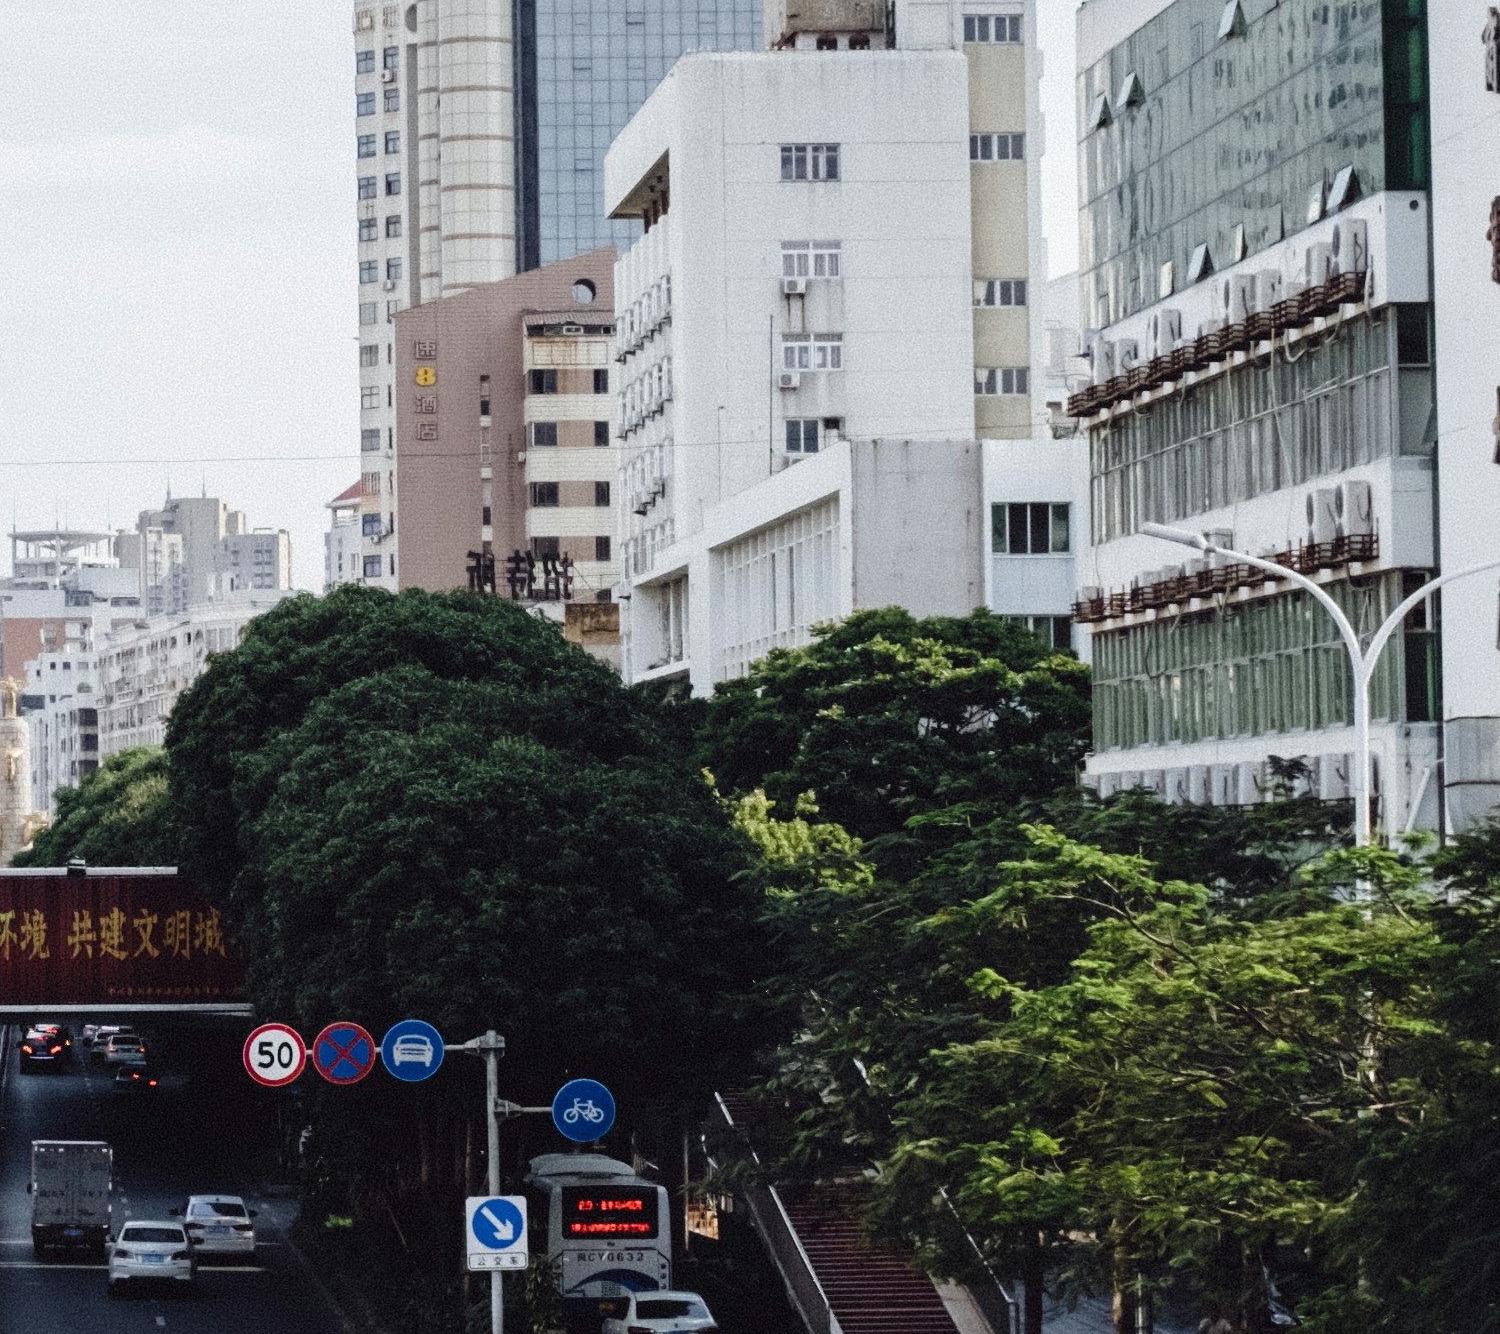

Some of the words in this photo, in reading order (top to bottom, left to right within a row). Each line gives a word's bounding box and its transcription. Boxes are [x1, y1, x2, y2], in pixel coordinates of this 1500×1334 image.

[414, 339, 438, 442] 速8酒店
[257, 1042, 294, 1070] 50
